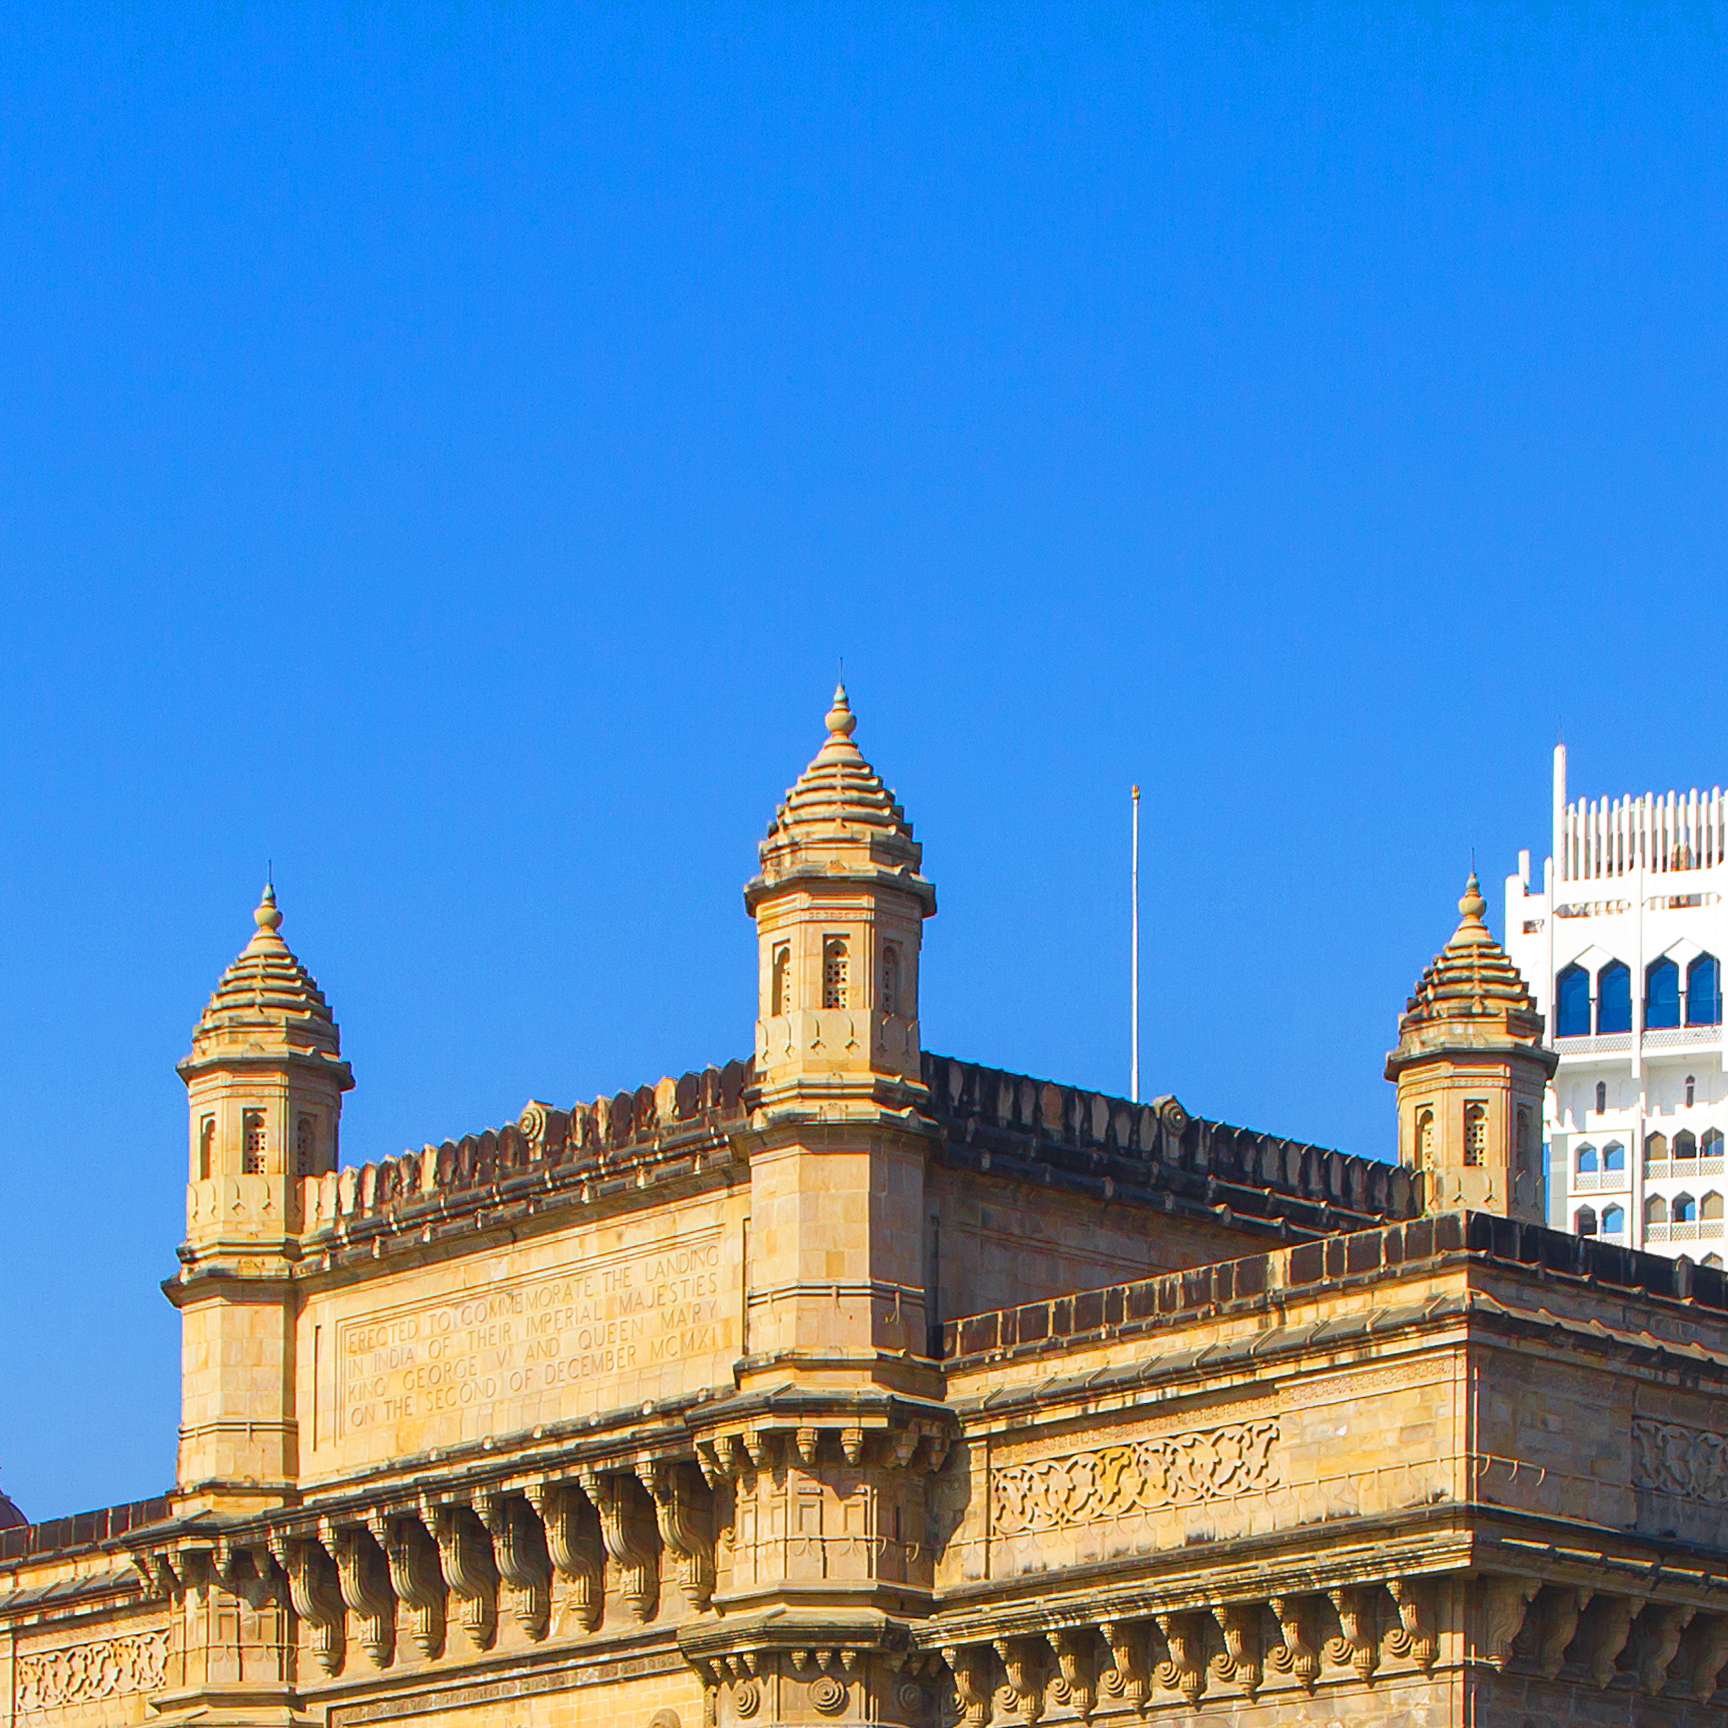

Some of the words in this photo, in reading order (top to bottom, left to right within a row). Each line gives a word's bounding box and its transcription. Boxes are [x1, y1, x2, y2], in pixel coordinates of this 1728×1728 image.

[348, 1319, 418, 1354] ERECTED
[427, 1311, 451, 1335] TO
[461, 1276, 594, 1326] COMMEMORATE
[602, 1266, 633, 1293] THE
[645, 1246, 720, 1282] LANDING
[348, 1356, 364, 1379] IN
[374, 1348, 415, 1373] INDIA
[428, 1337, 451, 1360] OF
[468, 1322, 512, 1350] THEIR
[526, 1302, 603, 1338] IMPERIAL
[619, 1273, 718, 1313] MAJESTIES
[348, 1377, 386, 1403] KING
[403, 1356, 478, 1391] GEORGE
[525, 1337, 560, 1361] AND
[578, 1317, 644, 1350] QUEEN
[661, 1299, 718, 1330] MARY
[351, 1405, 376, 1428] ON
[384, 1395, 413, 1421] THE
[426, 1378, 497, 1412] SECOND
[509, 1367, 533, 1392] OF
[545, 1345, 637, 1385] DECEMBER
[650, 1326, 717, 1361] MCMXI
